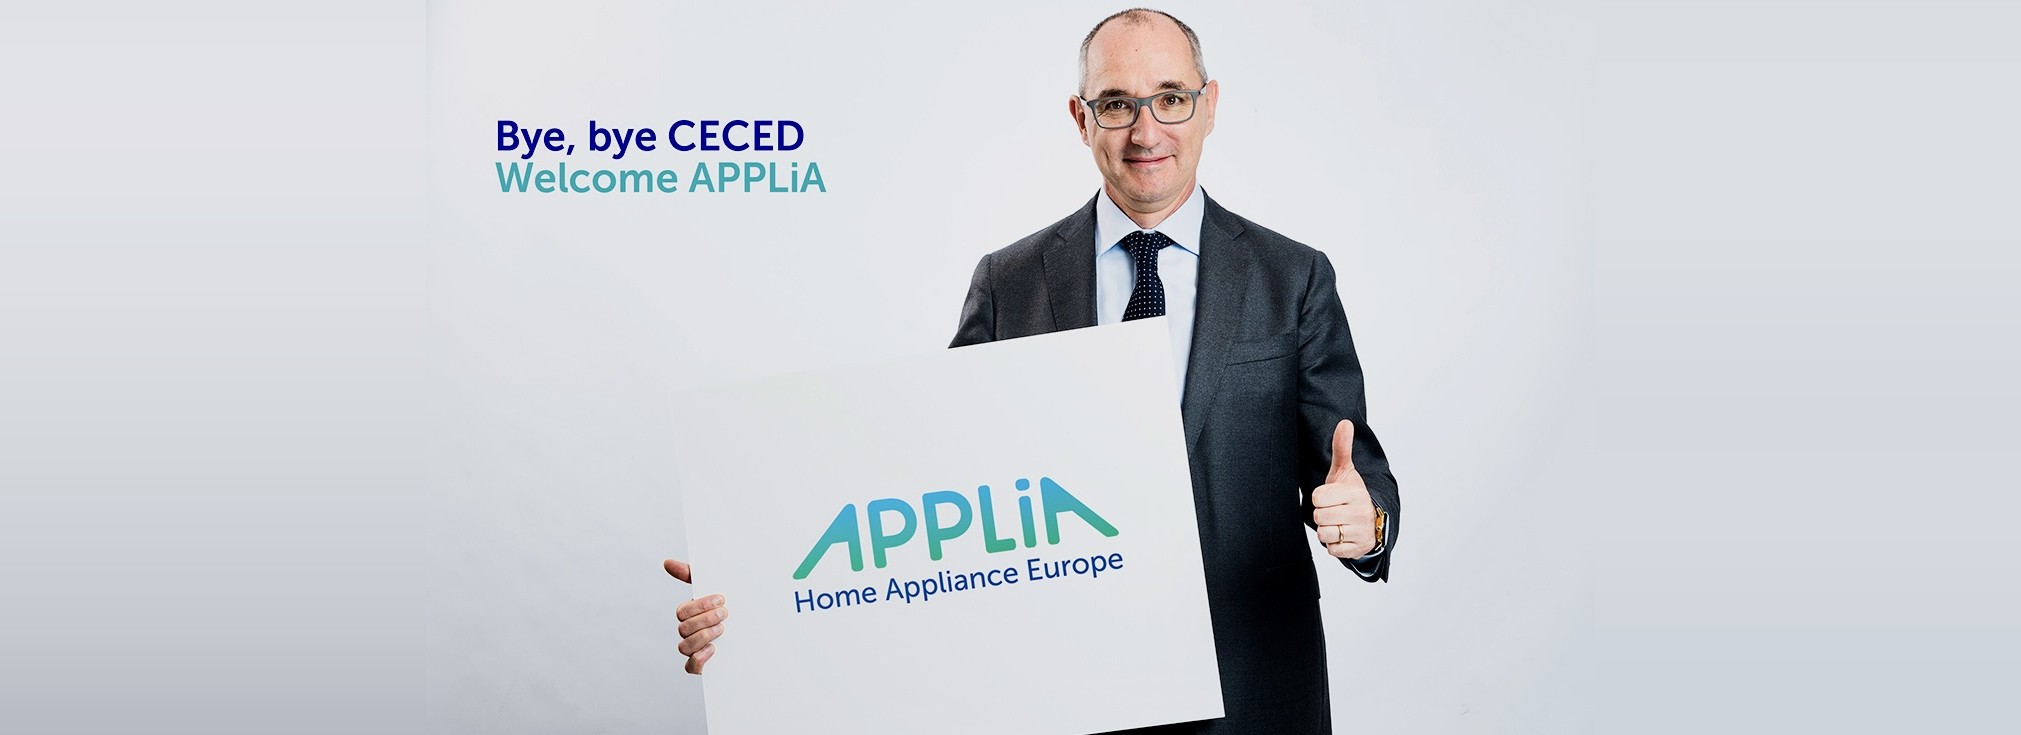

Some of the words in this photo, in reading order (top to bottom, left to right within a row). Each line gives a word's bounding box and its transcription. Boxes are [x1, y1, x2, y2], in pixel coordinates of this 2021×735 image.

[792, 476, 1120, 581] APPLiA
[794, 583, 877, 613] Home
[885, 569, 1019, 604] Appliance
[1026, 552, 1123, 582] Europe
